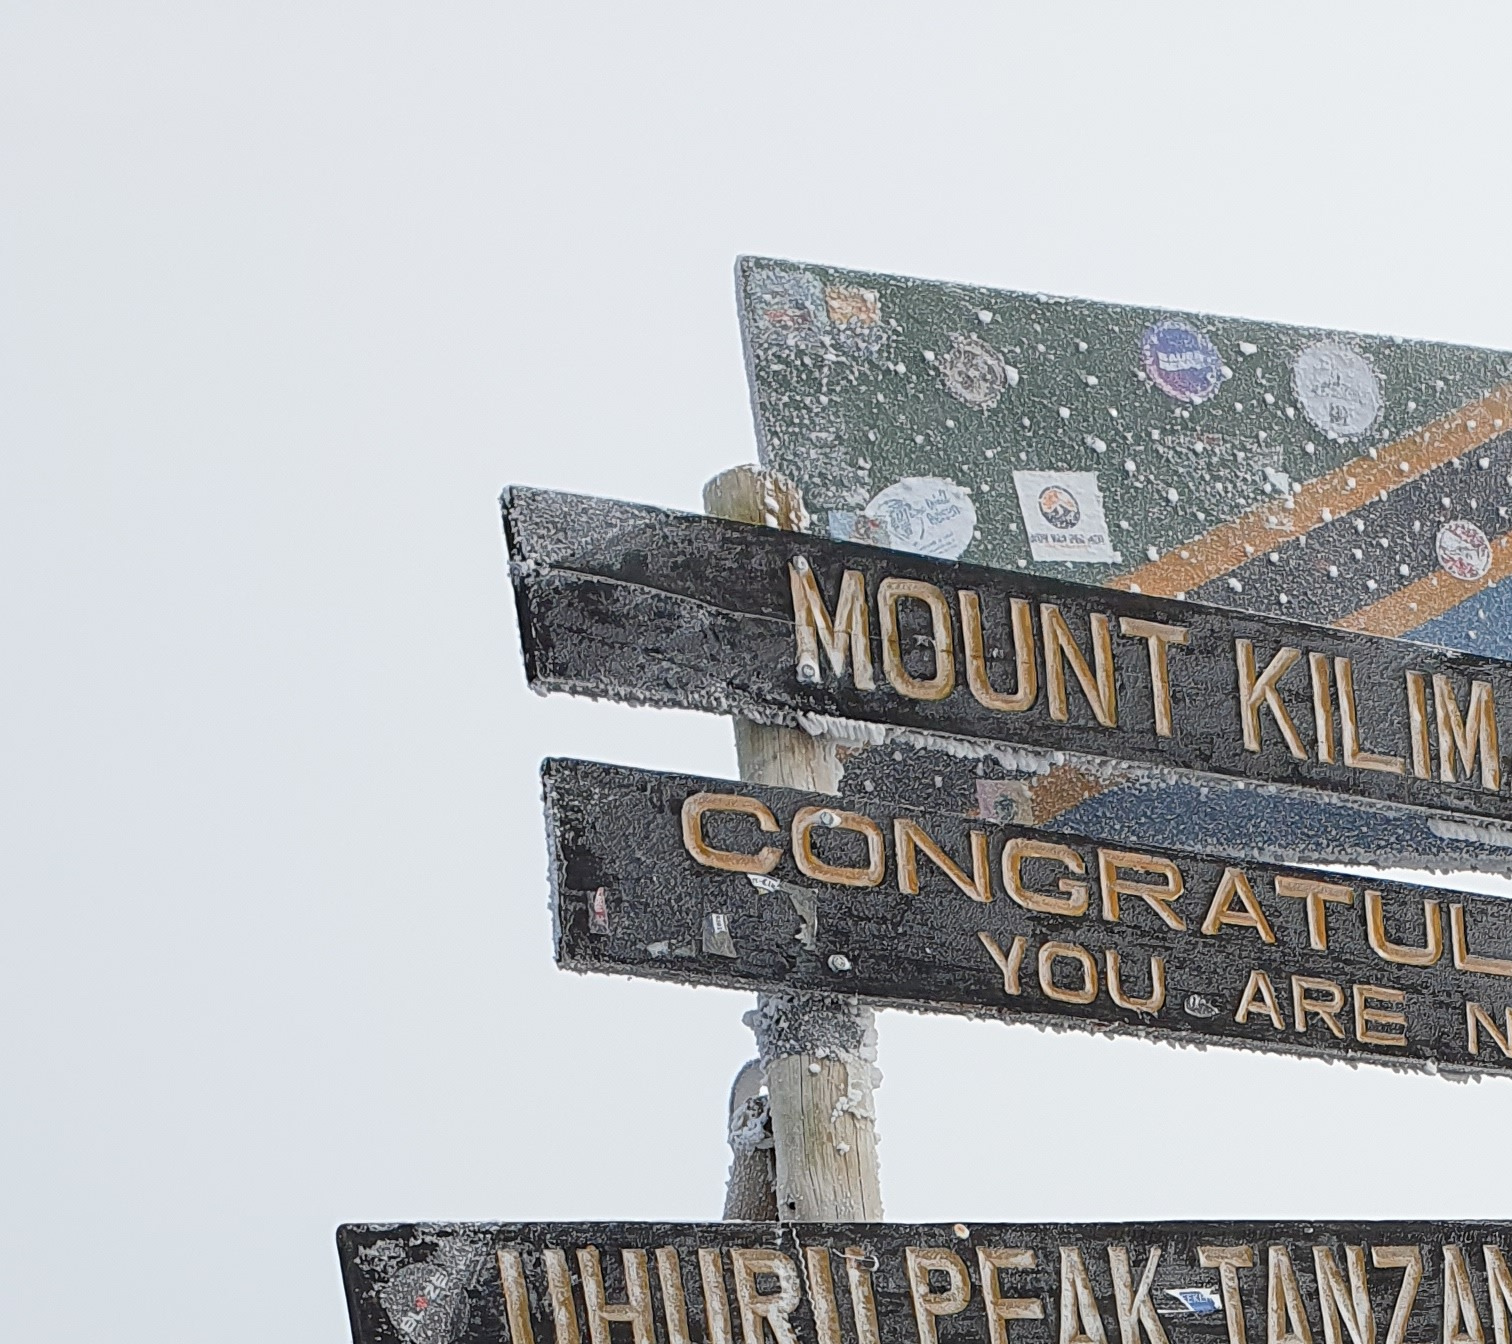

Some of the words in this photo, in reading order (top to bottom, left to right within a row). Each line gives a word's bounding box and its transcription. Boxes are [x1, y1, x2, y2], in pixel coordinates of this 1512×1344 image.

[789, 557, 1189, 737] MOUNT
[978, 932, 1166, 1013] YOU
[1235, 969, 1407, 1046] ARE
